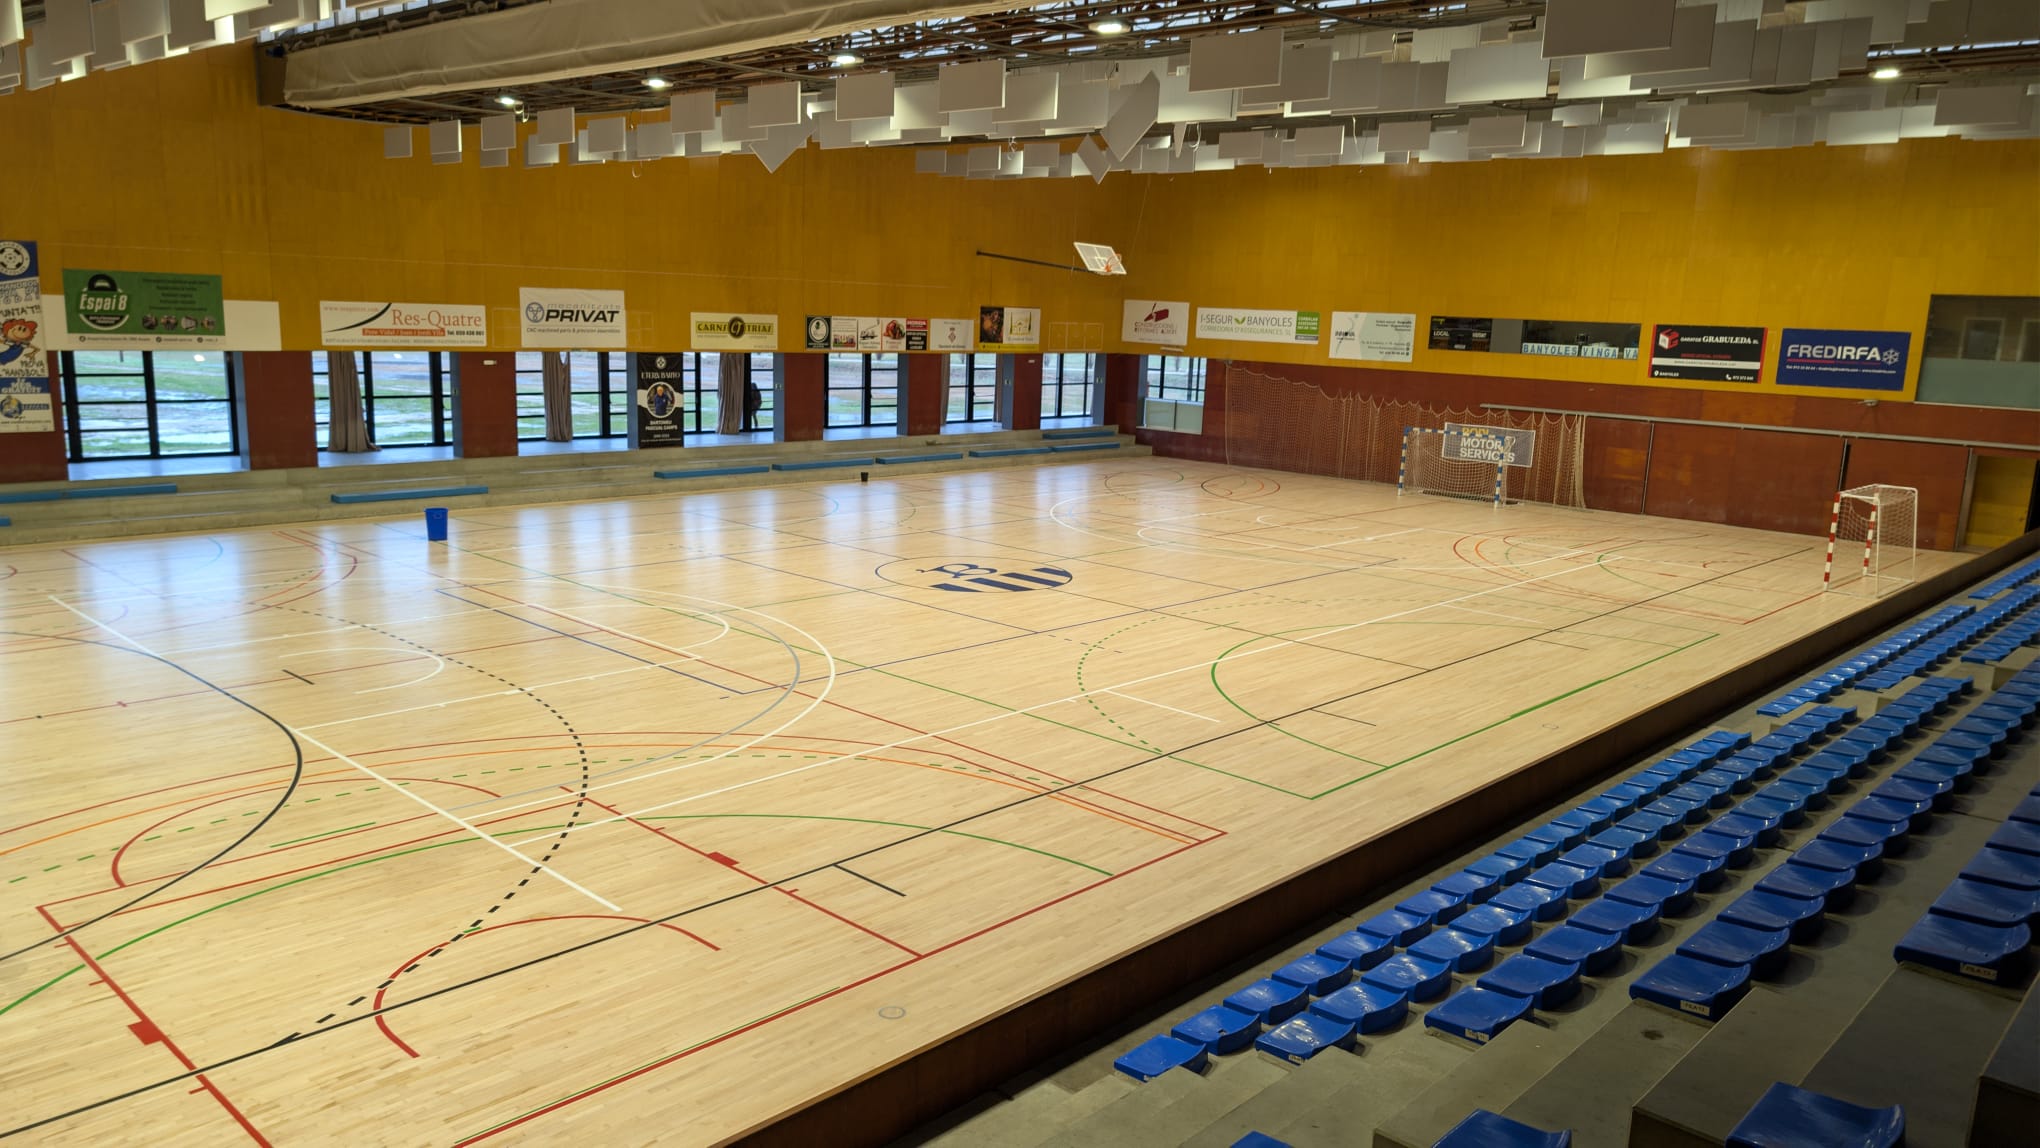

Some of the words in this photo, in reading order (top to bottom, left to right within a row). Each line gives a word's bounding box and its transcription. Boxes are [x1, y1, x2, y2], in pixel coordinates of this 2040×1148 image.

[80, 293, 116, 312] Espai
[118, 294, 128, 311] 8
[392, 309, 482, 328] Res-Quatre
[545, 310, 620, 323] PRIVAT
[1200, 314, 1233, 325] I-SEGUR
[1247, 316, 1293, 327] BANYOLES
[1702, 335, 1752, 345] GRABULEDA
[1523, 343, 1578, 356] BANYOLES
[1583, 347, 1618, 358] VINGA
[1787, 344, 1881, 361] FREDIRFA
[1460, 437, 1502, 450] MOTOR
[1460, 448, 1515, 462] SERVICS
